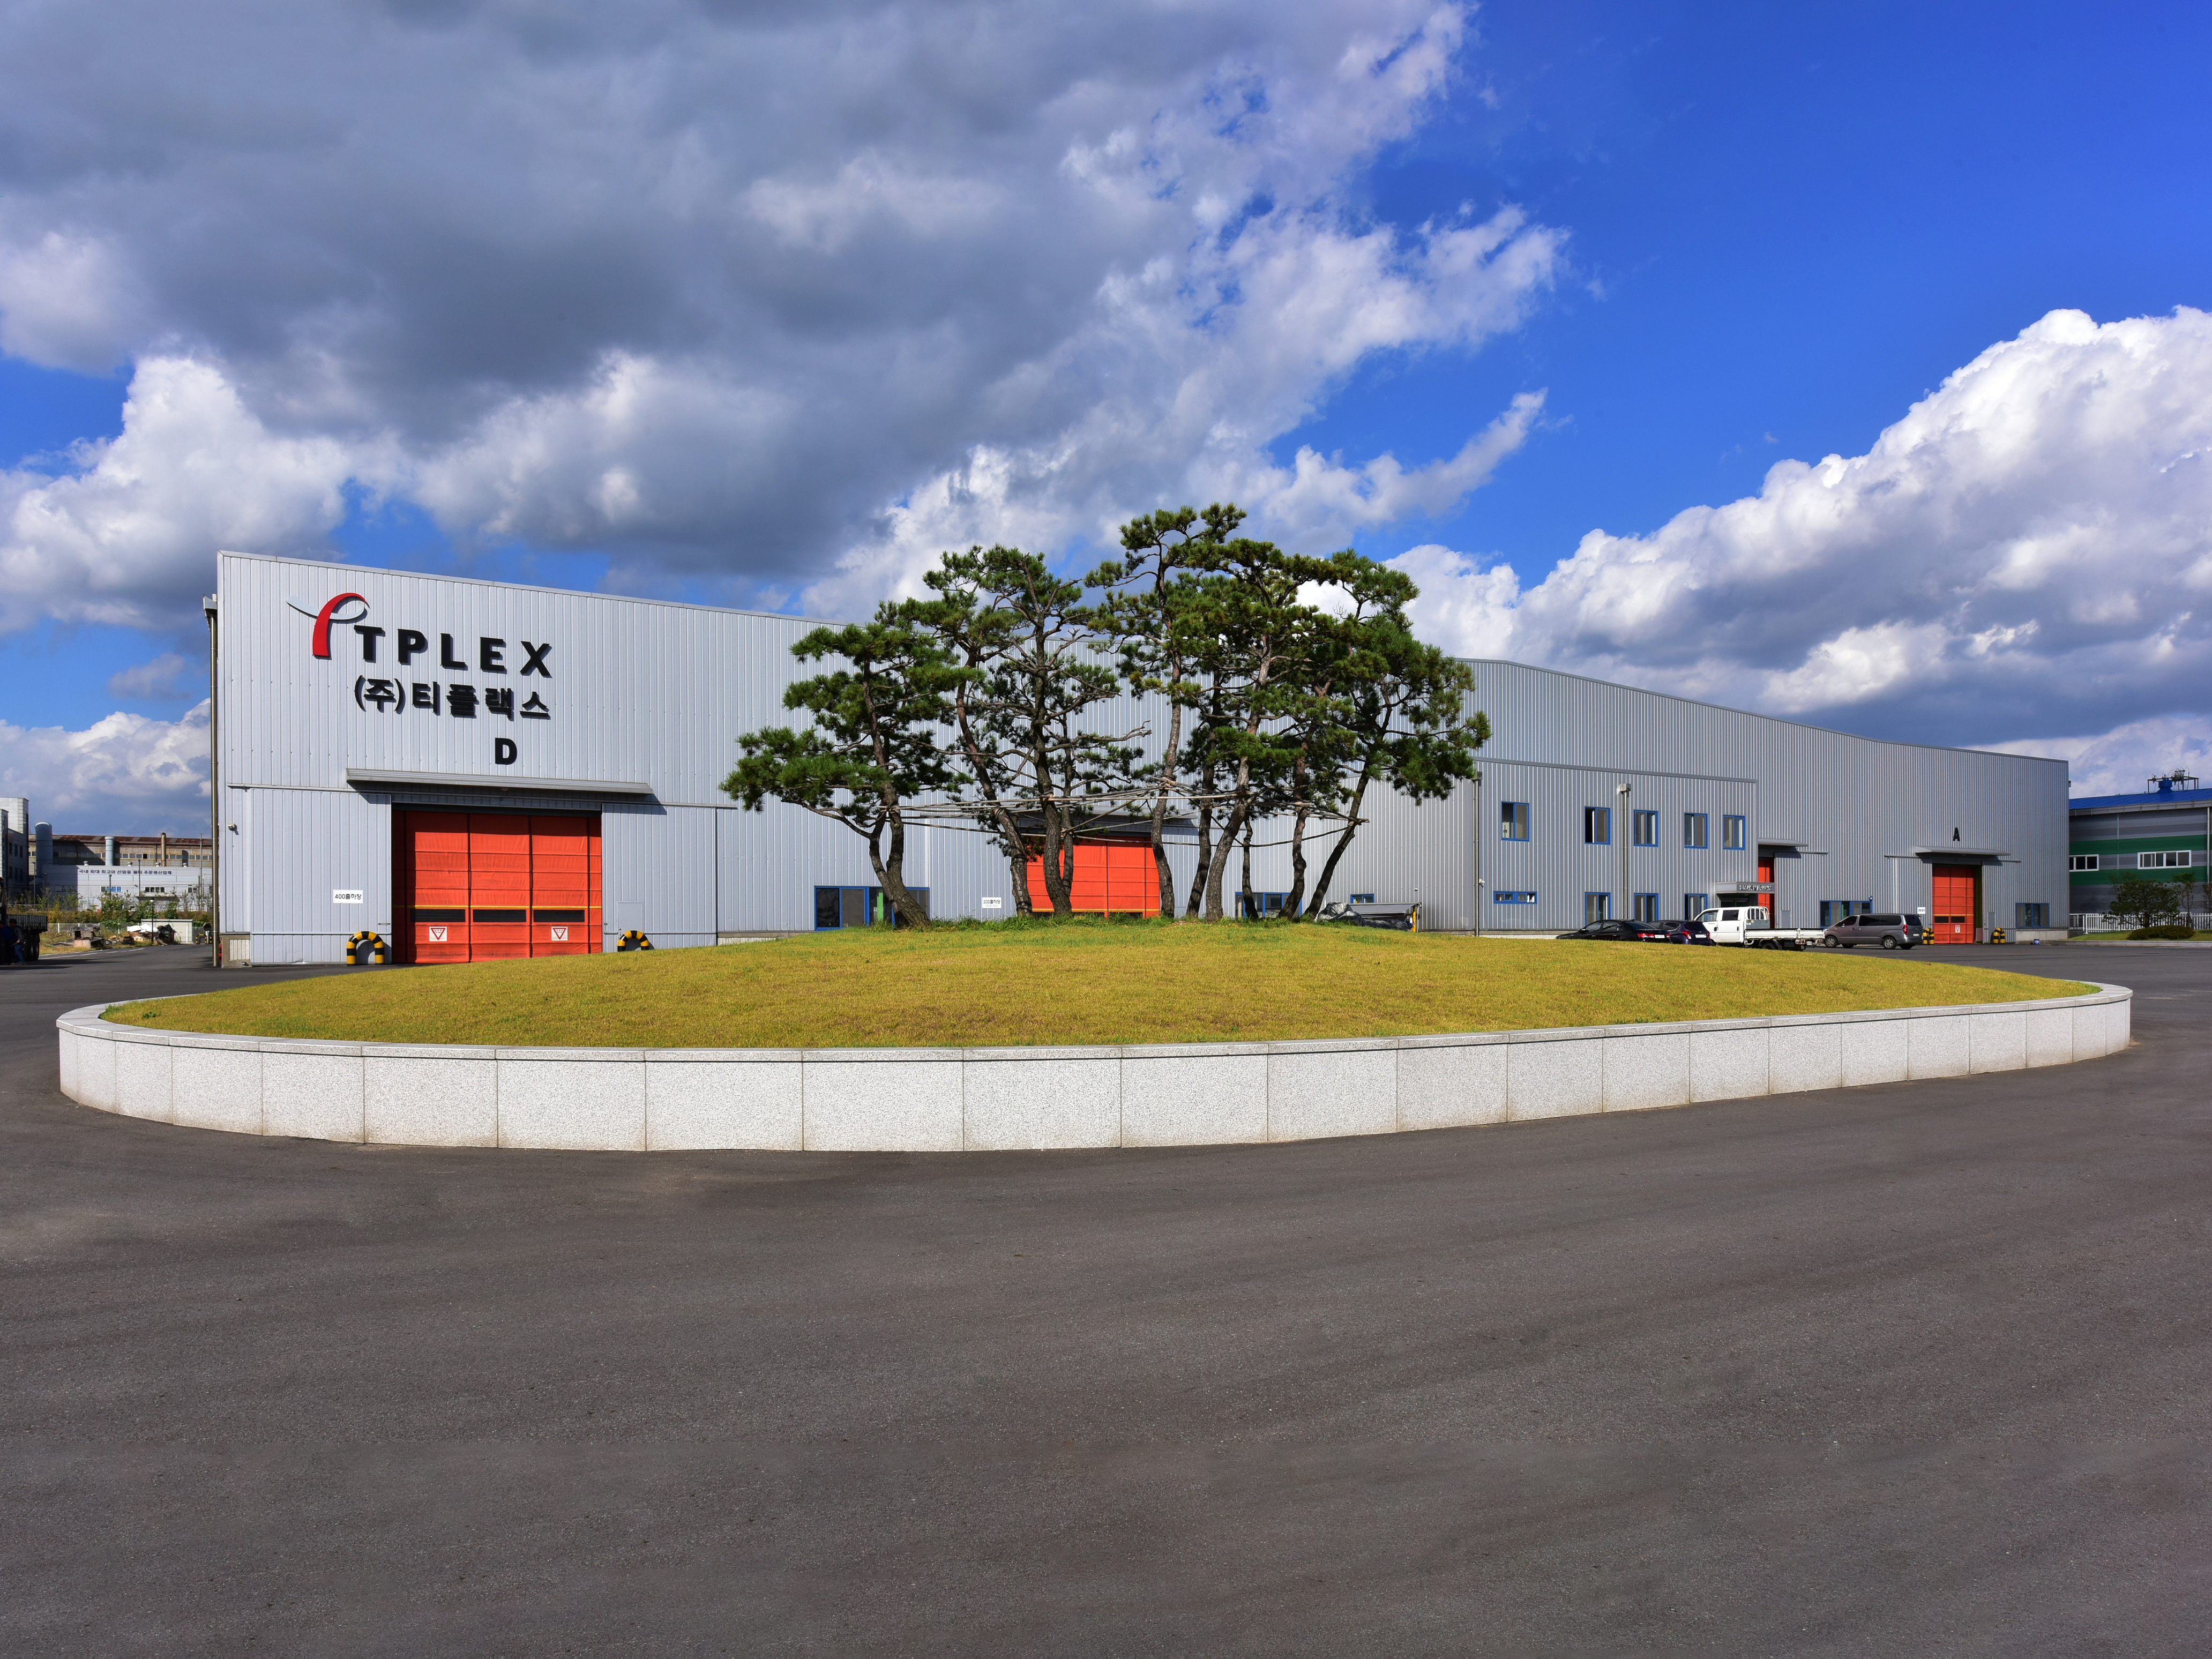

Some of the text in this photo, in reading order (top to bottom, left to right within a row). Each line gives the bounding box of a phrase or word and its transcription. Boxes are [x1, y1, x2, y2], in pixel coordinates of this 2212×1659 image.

[354, 625, 551, 678] TPLEX
[354, 675, 550, 720] (주)티플랙스
[495, 737, 517, 765] D
[1953, 827, 1960, 841] A
